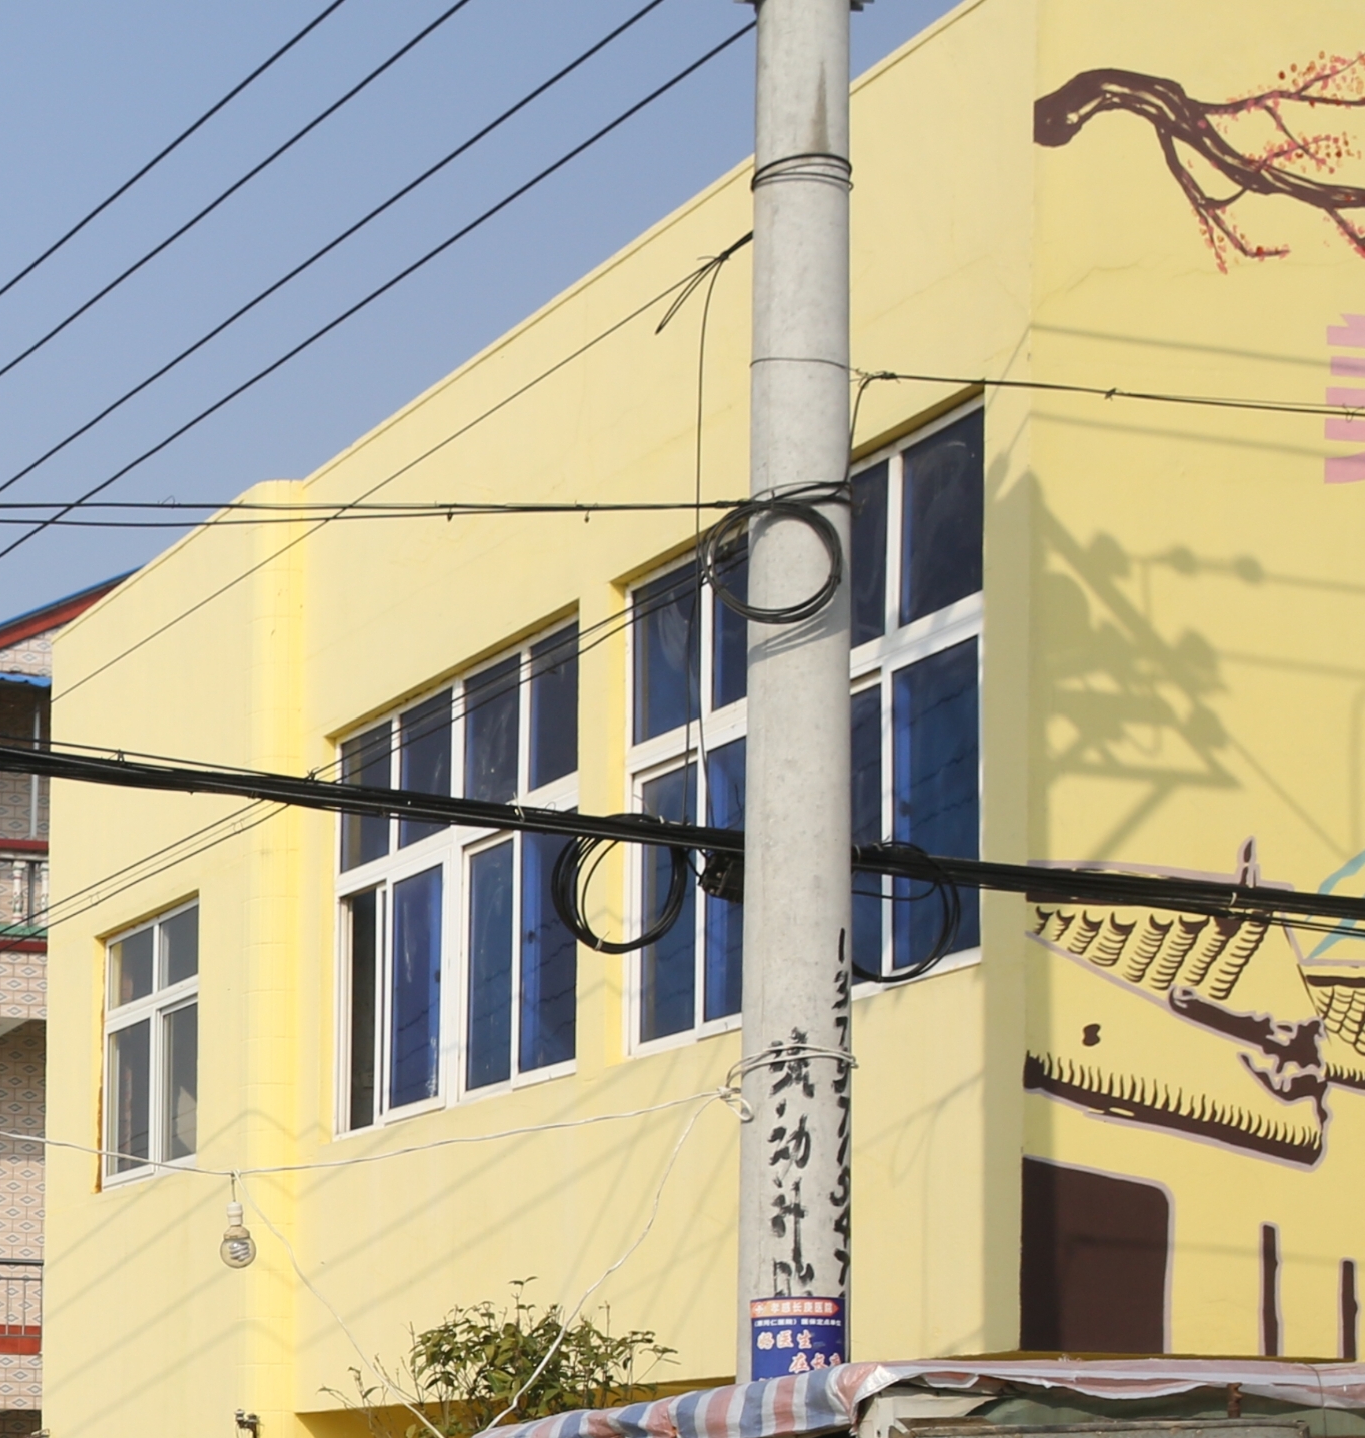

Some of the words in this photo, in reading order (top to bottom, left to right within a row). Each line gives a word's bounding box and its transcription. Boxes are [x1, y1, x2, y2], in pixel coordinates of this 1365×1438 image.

[828, 927, 850, 1297] 137971547
[770, 1301, 833, 1314] 孝感长庚医院
